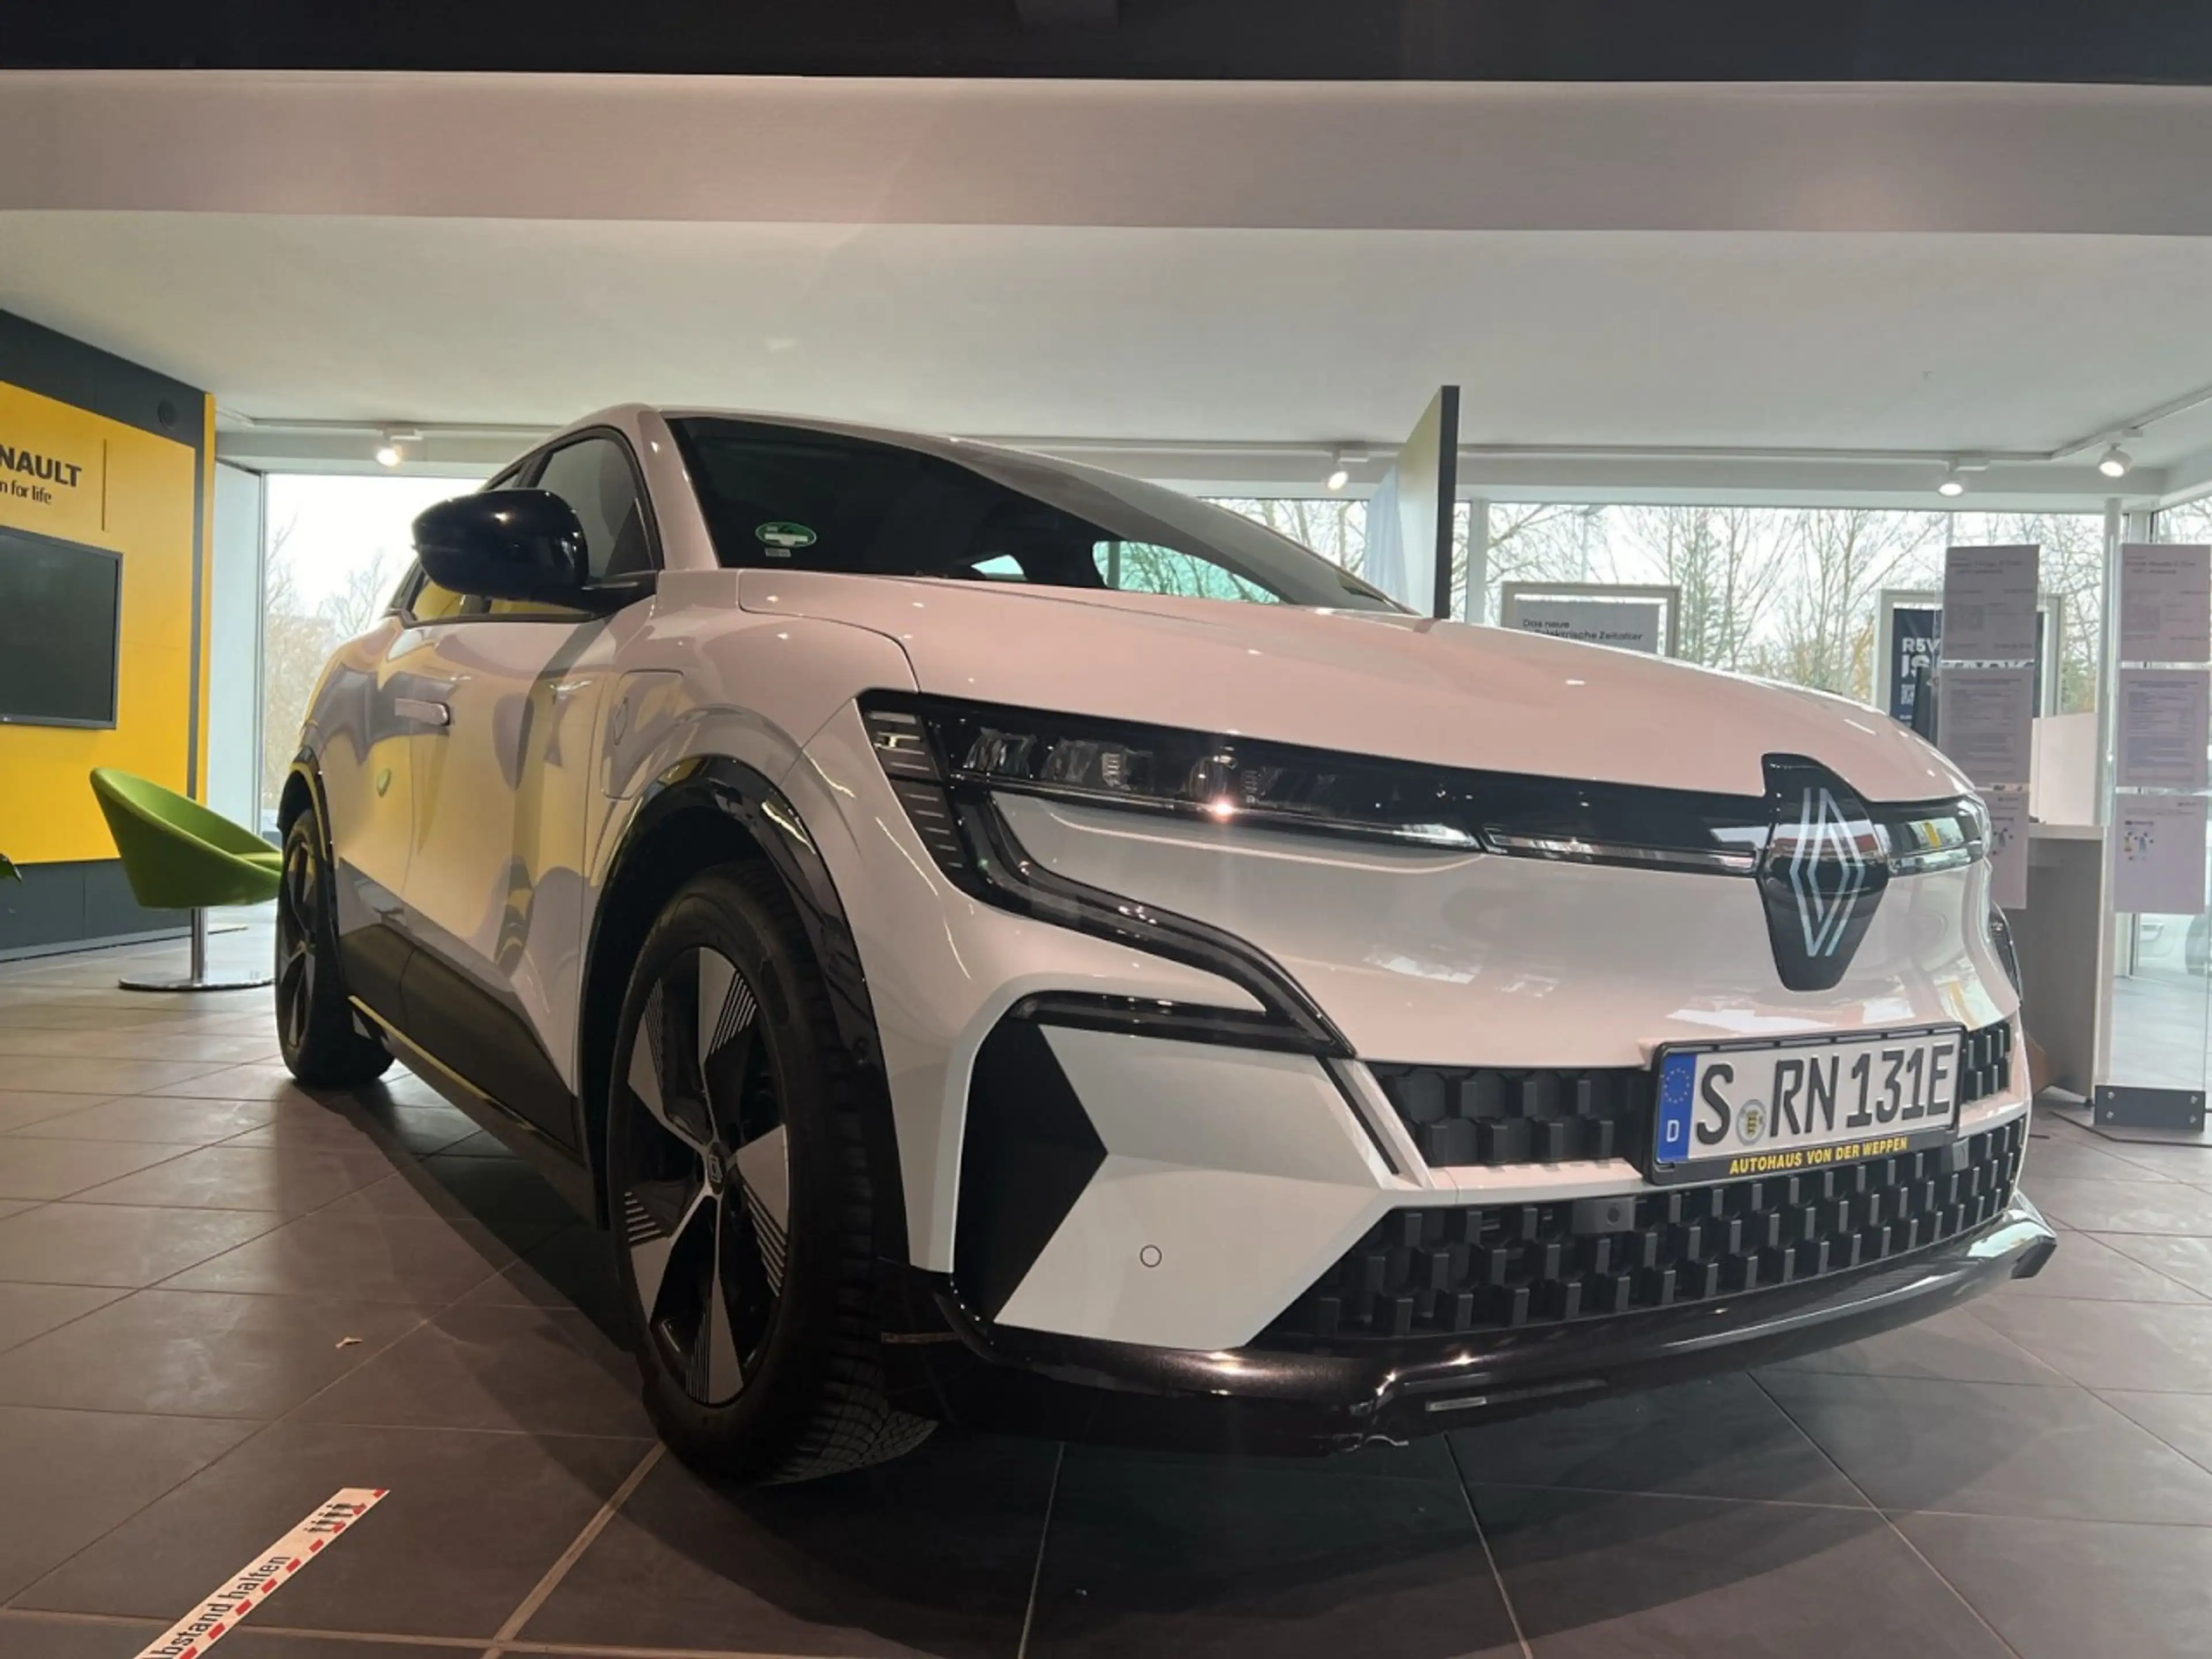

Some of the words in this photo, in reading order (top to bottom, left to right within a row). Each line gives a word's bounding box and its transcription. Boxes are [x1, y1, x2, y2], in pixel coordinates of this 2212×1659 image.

[12, 479, 29, 498] for
[32, 485, 52, 505] life
[1696, 1063, 1734, 1145] S
[1770, 1055, 1839, 1137] RN
[1846, 1044, 1953, 1127] 131E
[1666, 1119, 1679, 1142] D
[1729, 1152, 1802, 1175] AUTOHAUS
[1806, 1148, 1832, 1165] VON
[1835, 1145, 1859, 1161] DER
[1862, 1138, 1908, 1157] WEPPEN
[142, 1604, 234, 1659] bstand
[218, 1556, 291, 1600] halten
